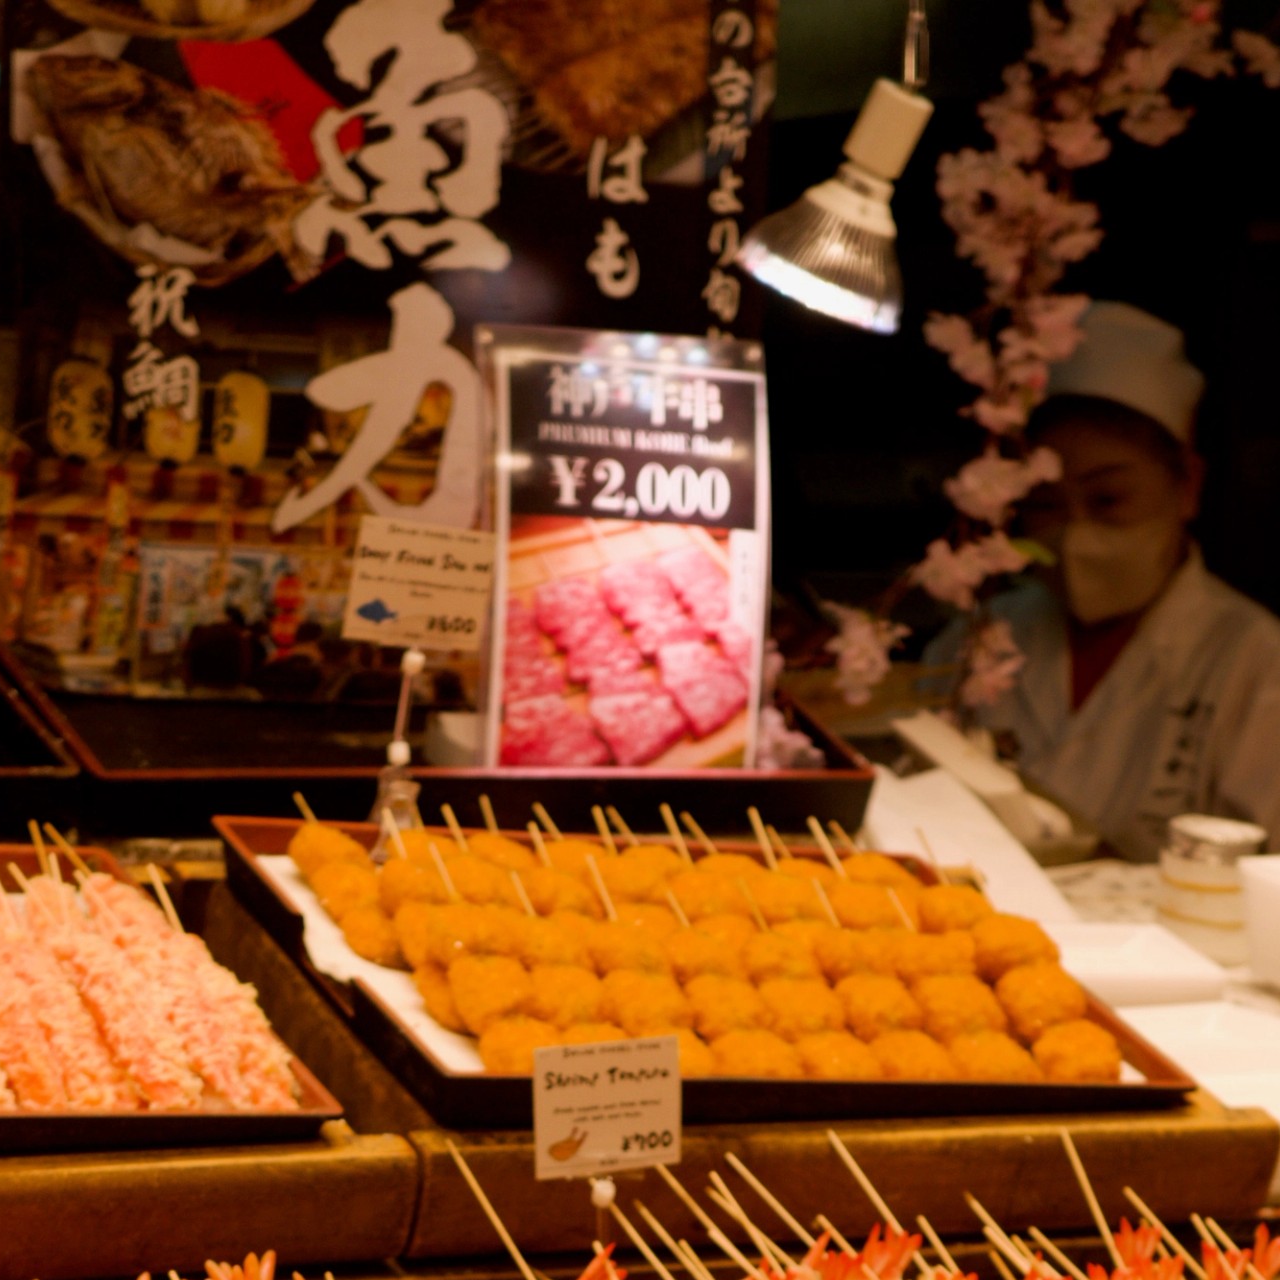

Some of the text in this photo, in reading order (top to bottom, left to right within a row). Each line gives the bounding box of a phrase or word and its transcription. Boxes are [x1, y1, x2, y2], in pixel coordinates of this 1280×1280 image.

[272, 0, 511, 532] 魚力
[585, 134, 649, 299] はも
[122, 263, 200, 421] 祝鯛
[548, 456, 731, 520] ¥2,000
[545, 1071, 599, 1090] Shrimp
[622, 1129, 674, 1152] ¥700
